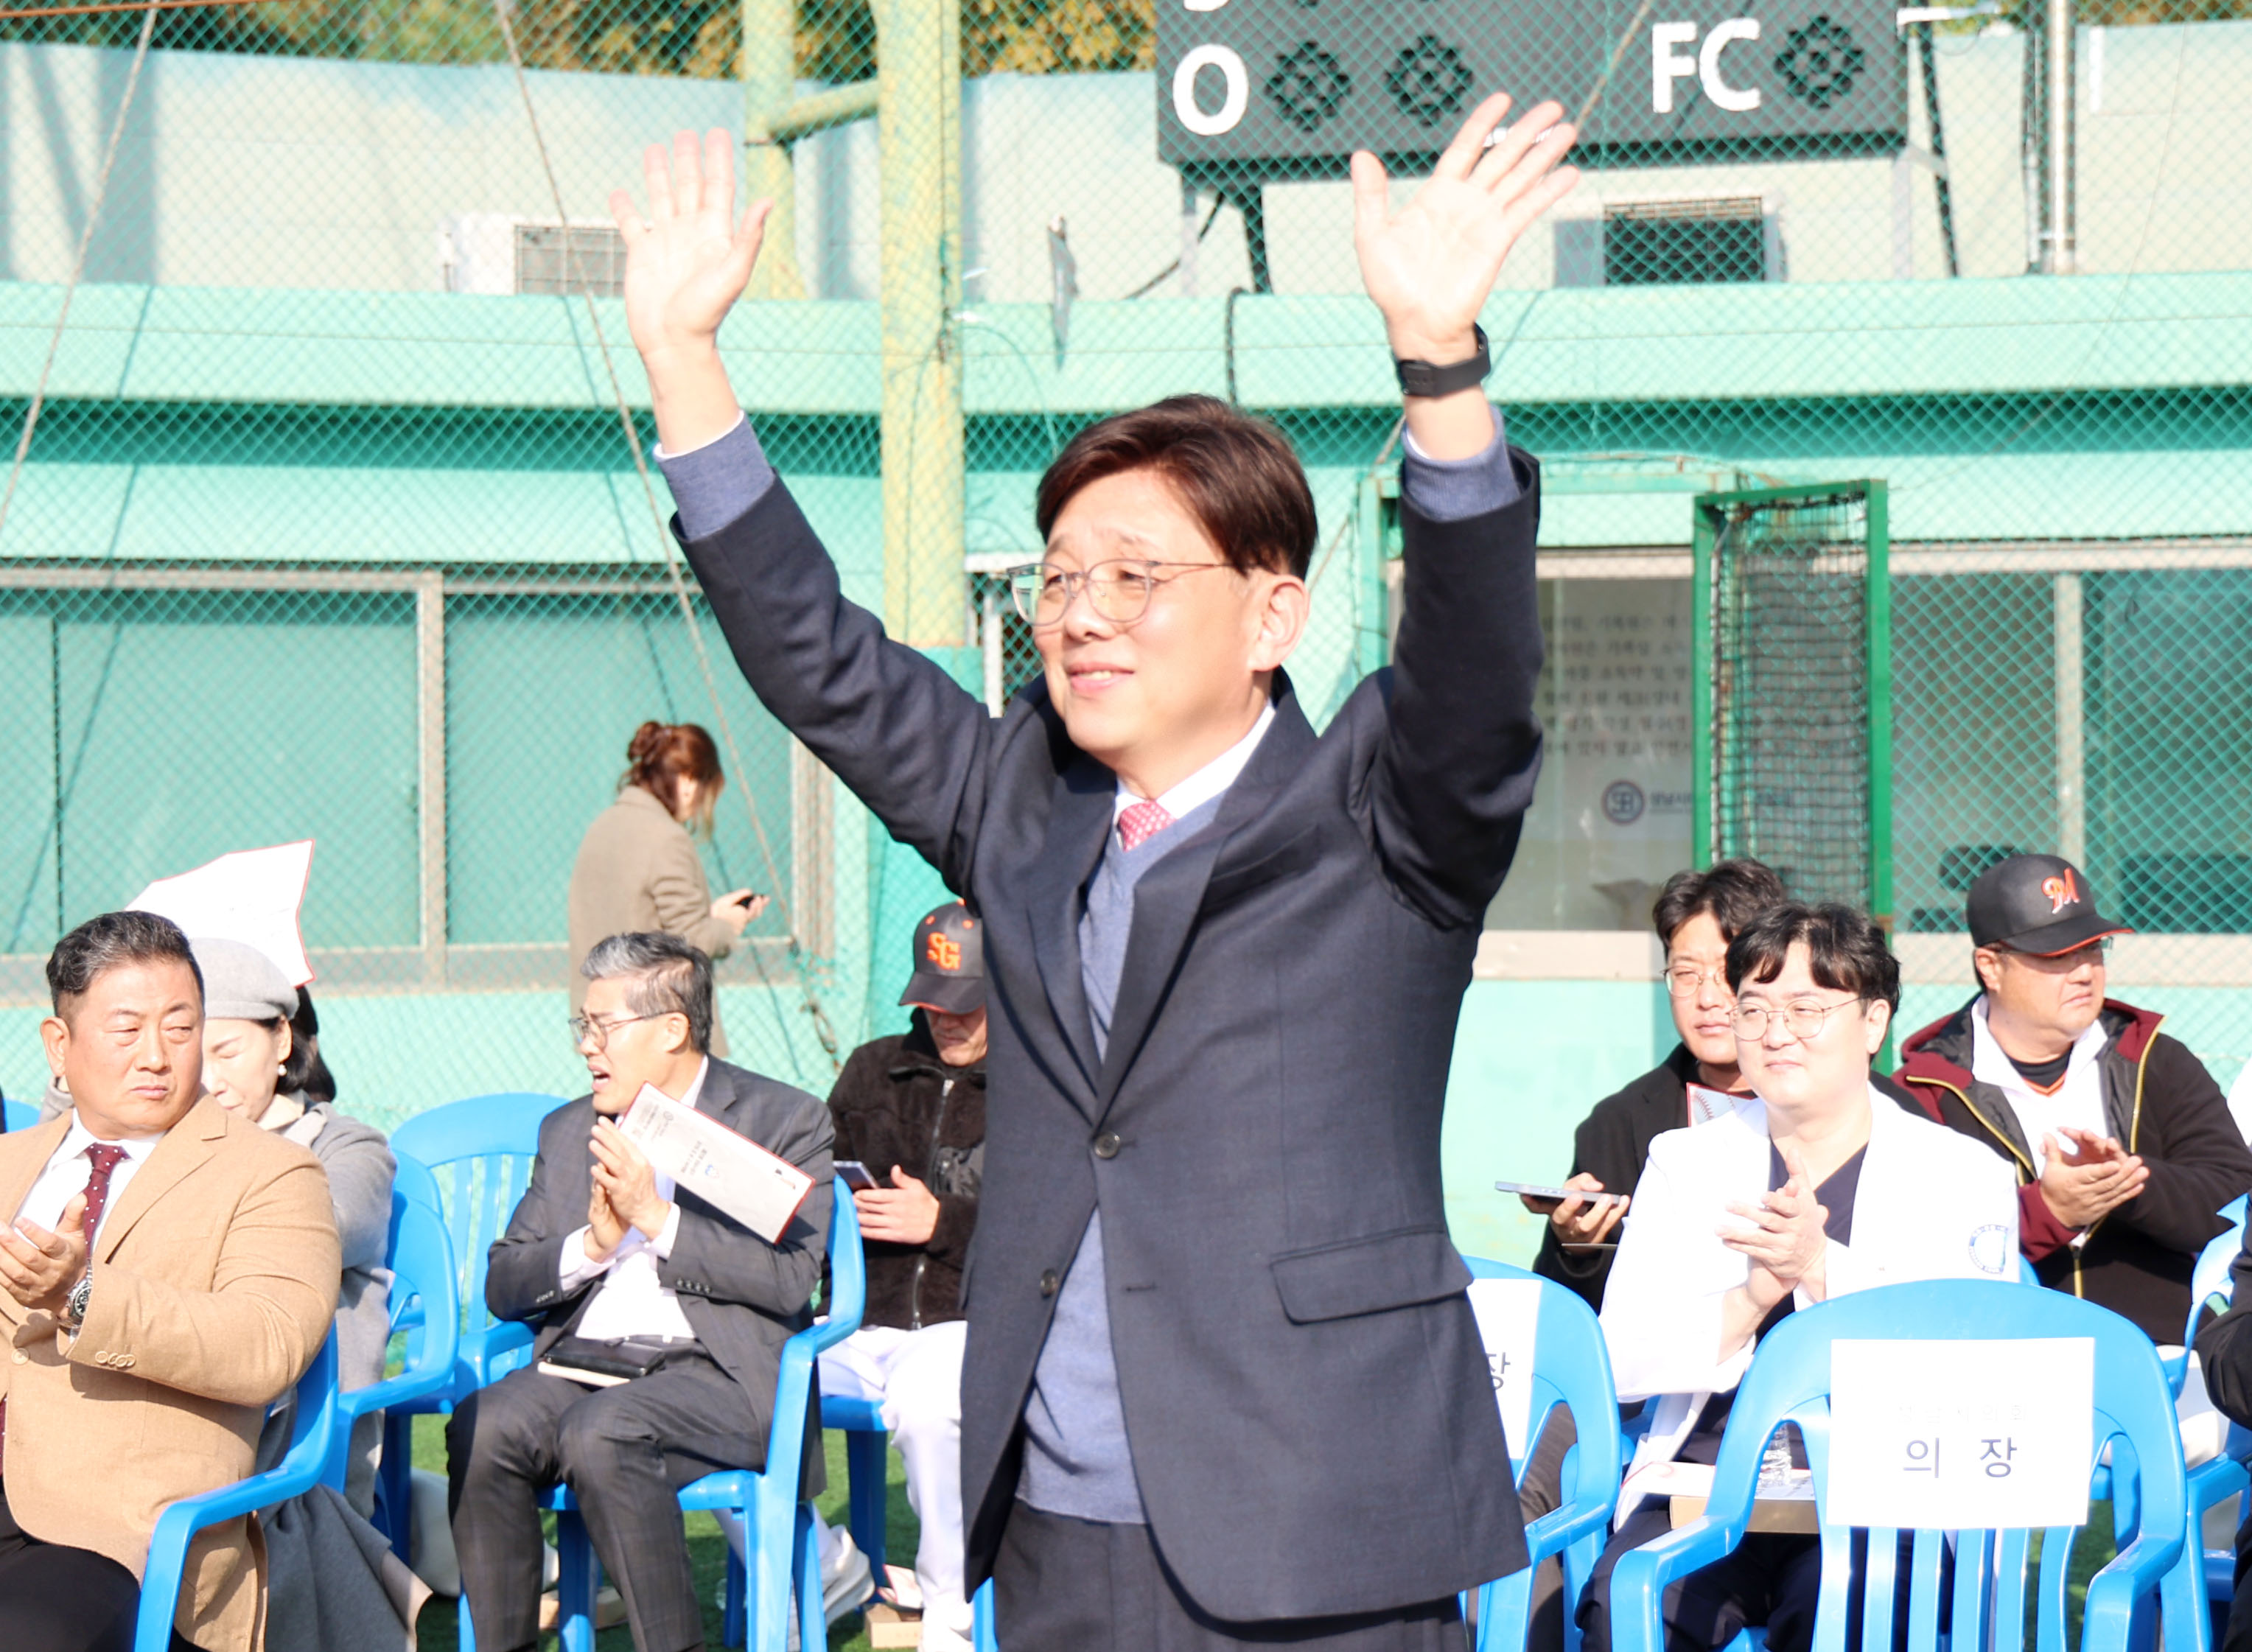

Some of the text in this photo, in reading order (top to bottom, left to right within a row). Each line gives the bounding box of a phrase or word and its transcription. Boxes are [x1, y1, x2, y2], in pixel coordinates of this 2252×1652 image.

[1172, 43, 1249, 136] O
[1652, 18, 1761, 113] FC
[2041, 867, 2080, 914] M
[926, 931, 962, 971] SG
